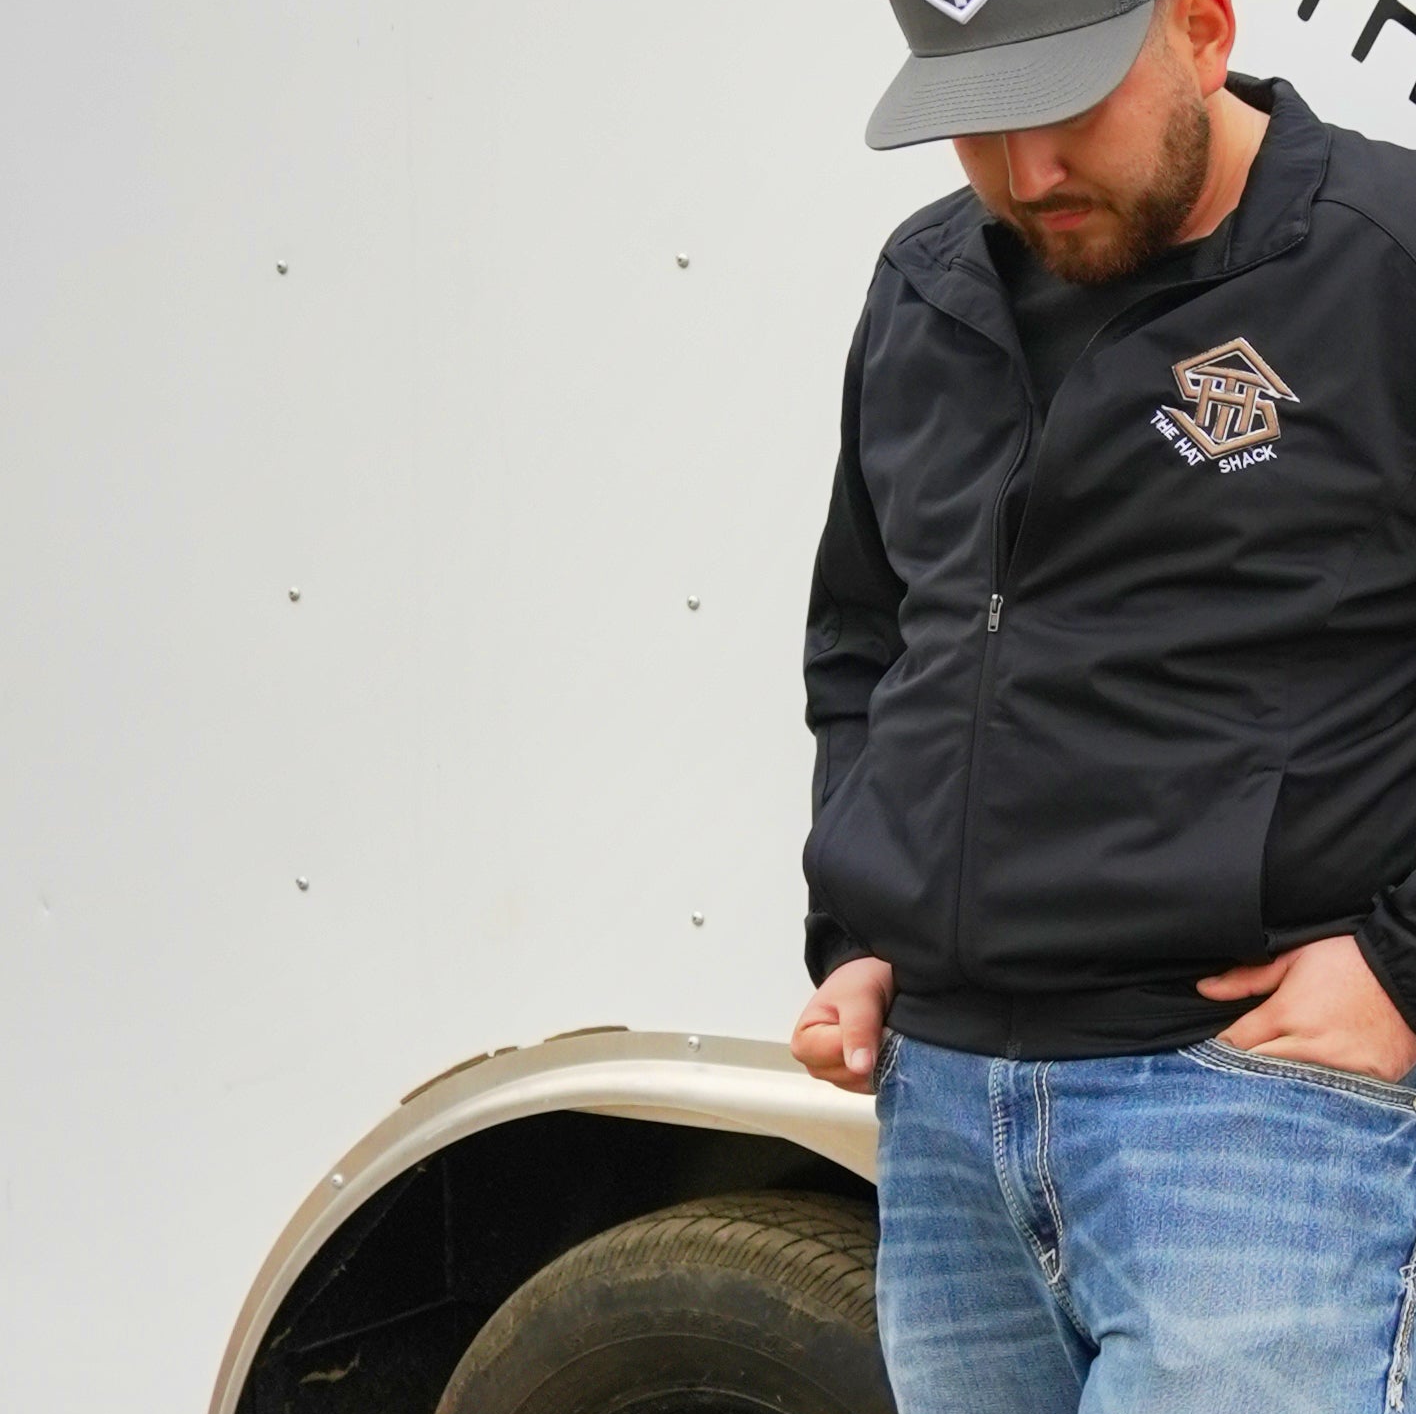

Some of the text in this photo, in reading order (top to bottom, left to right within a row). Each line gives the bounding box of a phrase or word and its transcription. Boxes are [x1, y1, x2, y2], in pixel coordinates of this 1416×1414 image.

[1151, 410, 1278, 474] THE HAT SHACK
